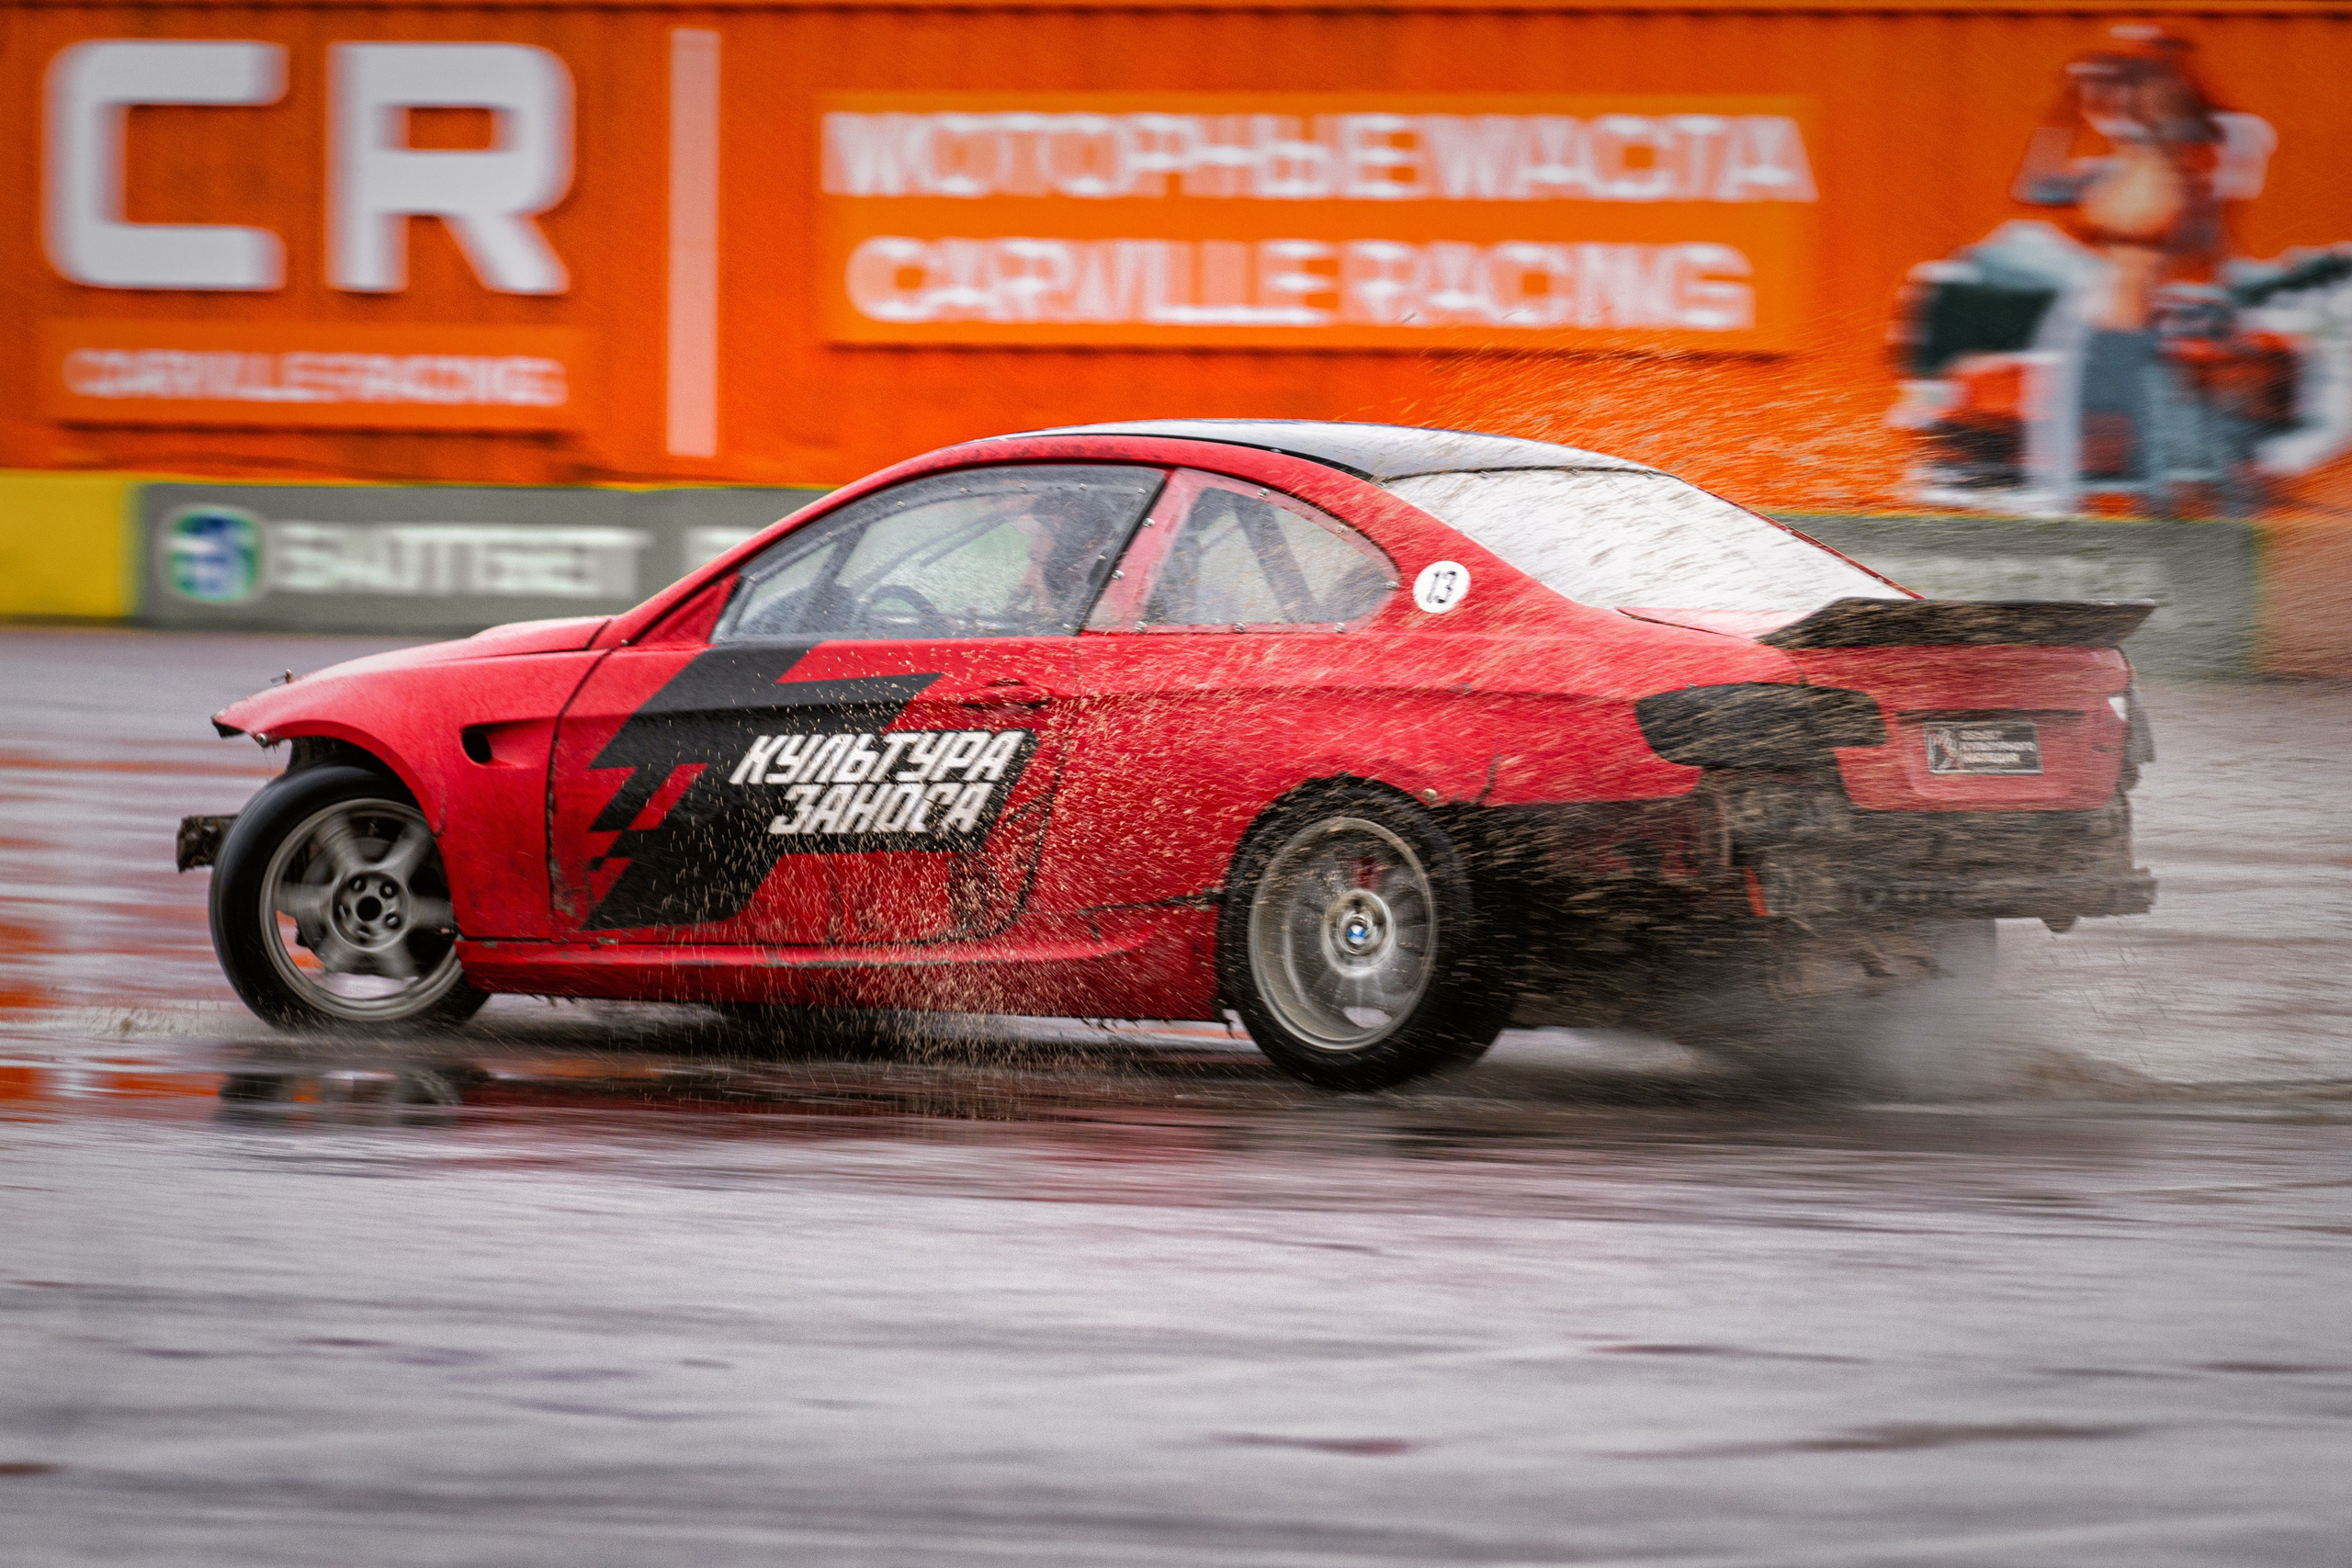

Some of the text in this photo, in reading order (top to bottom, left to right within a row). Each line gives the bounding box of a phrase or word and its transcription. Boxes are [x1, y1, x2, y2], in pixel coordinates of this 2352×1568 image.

[40, 38, 577, 295] CR
[1426, 570, 1457, 604] 13
[729, 730, 1026, 784] КУЛЬТУРА
[767, 782, 995, 834] ЗАНОСА
